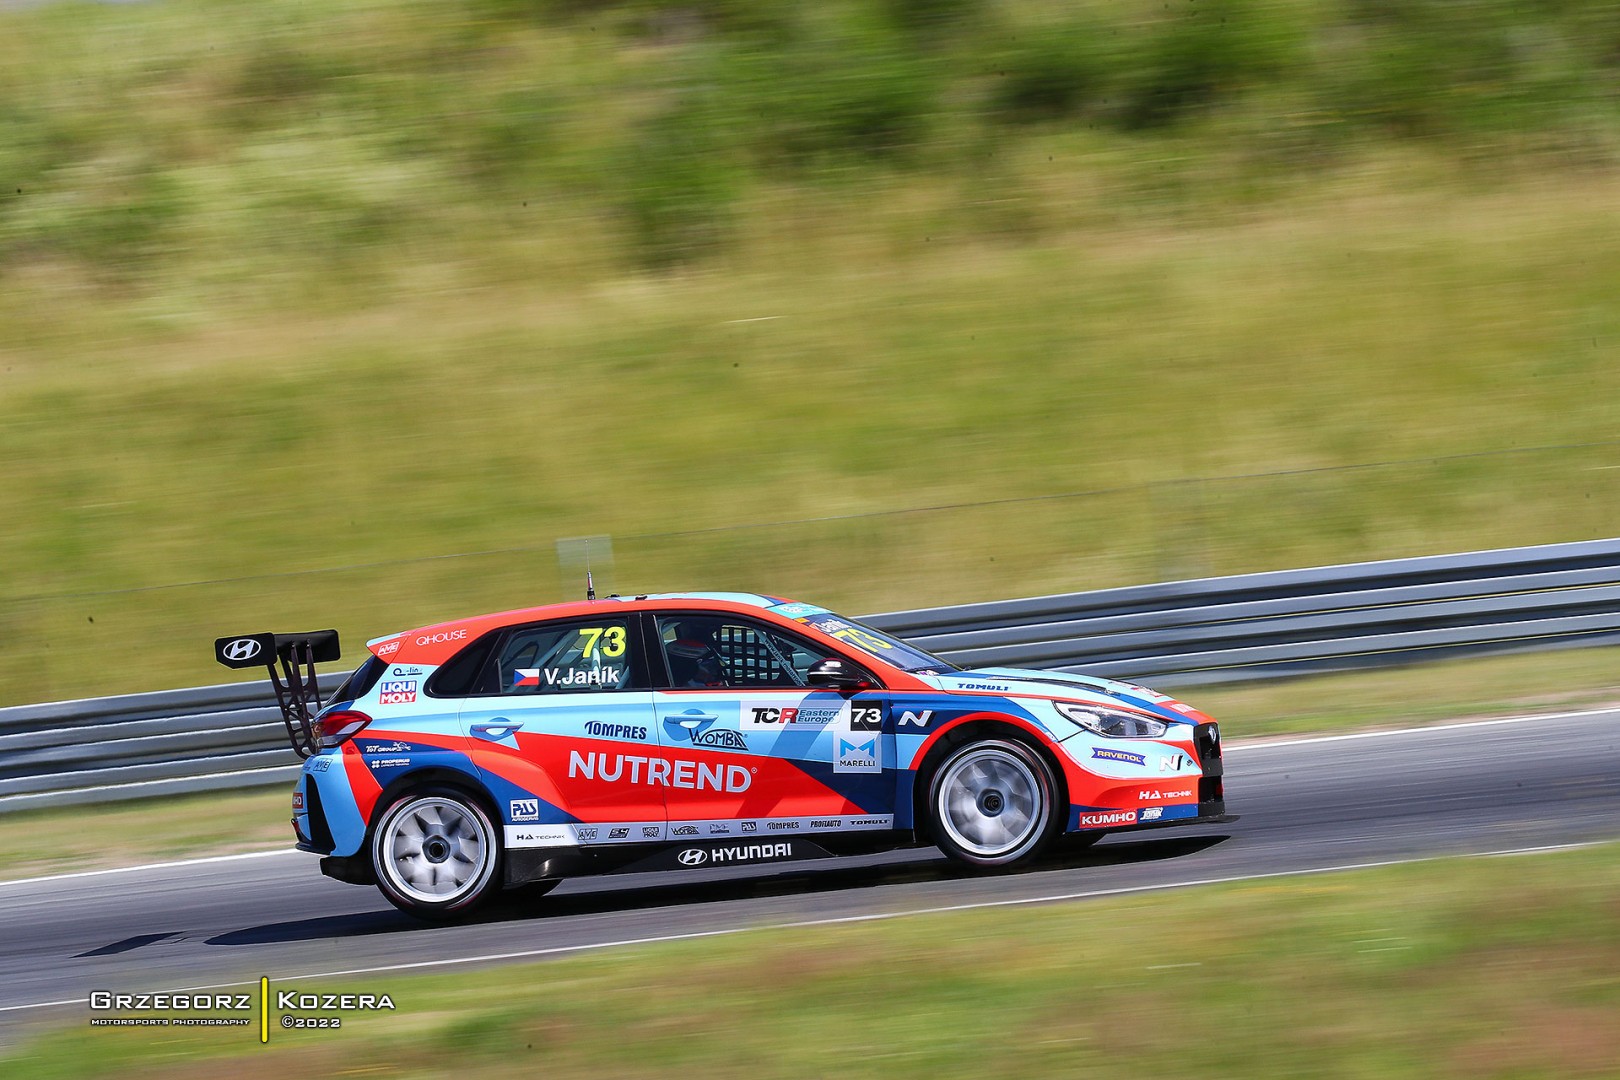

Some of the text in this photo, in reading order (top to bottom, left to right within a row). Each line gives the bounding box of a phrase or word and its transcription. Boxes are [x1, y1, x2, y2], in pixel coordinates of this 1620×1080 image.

[416, 629, 467, 646] QHOUSE
[579, 626, 626, 658] 73
[832, 628, 893, 653] 73
[544, 666, 620, 686] V.Janík
[382, 681, 416, 693] LIQUI
[957, 683, 1009, 691] TOMULI
[381, 693, 415, 704] MOLY
[751, 708, 798, 723] TCR
[852, 708, 881, 723] 73
[585, 721, 647, 740] TOMPRES
[1097, 751, 1142, 762] RAVENOL
[568, 750, 752, 793] NUTREND
[1082, 811, 1136, 825] KUMHO
[712, 843, 792, 862] HYUNDAI
